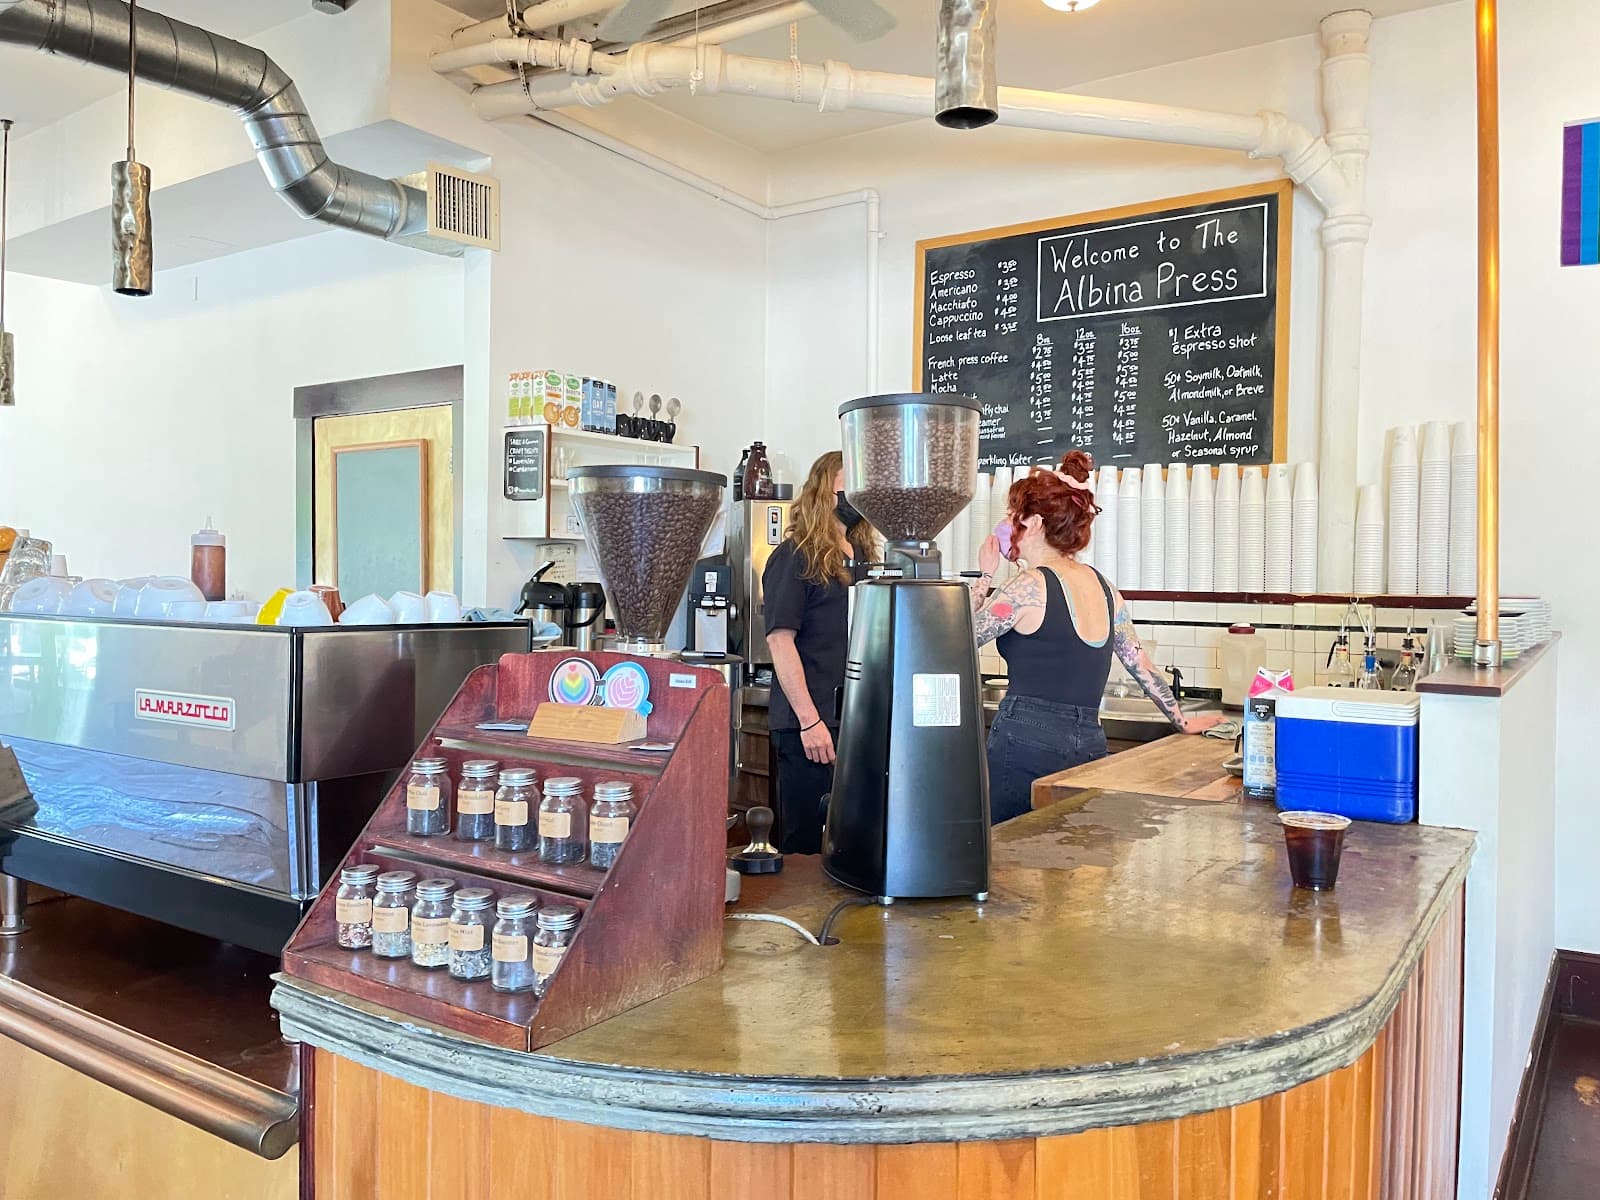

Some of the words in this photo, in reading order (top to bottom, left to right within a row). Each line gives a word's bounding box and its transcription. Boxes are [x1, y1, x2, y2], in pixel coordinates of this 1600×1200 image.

[1051, 239, 1139, 273] Welcome
[1157, 231, 1180, 252] to
[1195, 219, 1238, 249] The
[930, 270, 975, 286] Espresso
[929, 284, 978, 299] Americano
[1054, 274, 1143, 313] Albina
[1157, 262, 1238, 298] Press
[929, 297, 977, 313] Macchiato
[929, 310, 984, 328] Cappuccino
[929, 333, 953, 344] Loose
[956, 328, 972, 341] leaf
[974, 328, 986, 339] tea
[1184, 322, 1222, 340] Extra
[1172, 340, 1226, 360] espresso
[1229, 332, 1258, 349] shot
[928, 356, 955, 370] French
[958, 355, 978, 370] press
[981, 352, 1009, 364] coffee
[931, 371, 958, 382] Latte
[1184, 367, 1225, 384] Soymilk,
[931, 383, 957, 393] Mocha
[1236, 383, 1264, 397] Breve
[1213, 427, 1253, 442] Almond
[1171, 450, 1181, 458] or
[1184, 444, 1227, 458] Seasonal
[1230, 444, 1259, 459] syrup
[978, 454, 1007, 469] parkling
[1008, 452, 1033, 465] Water
